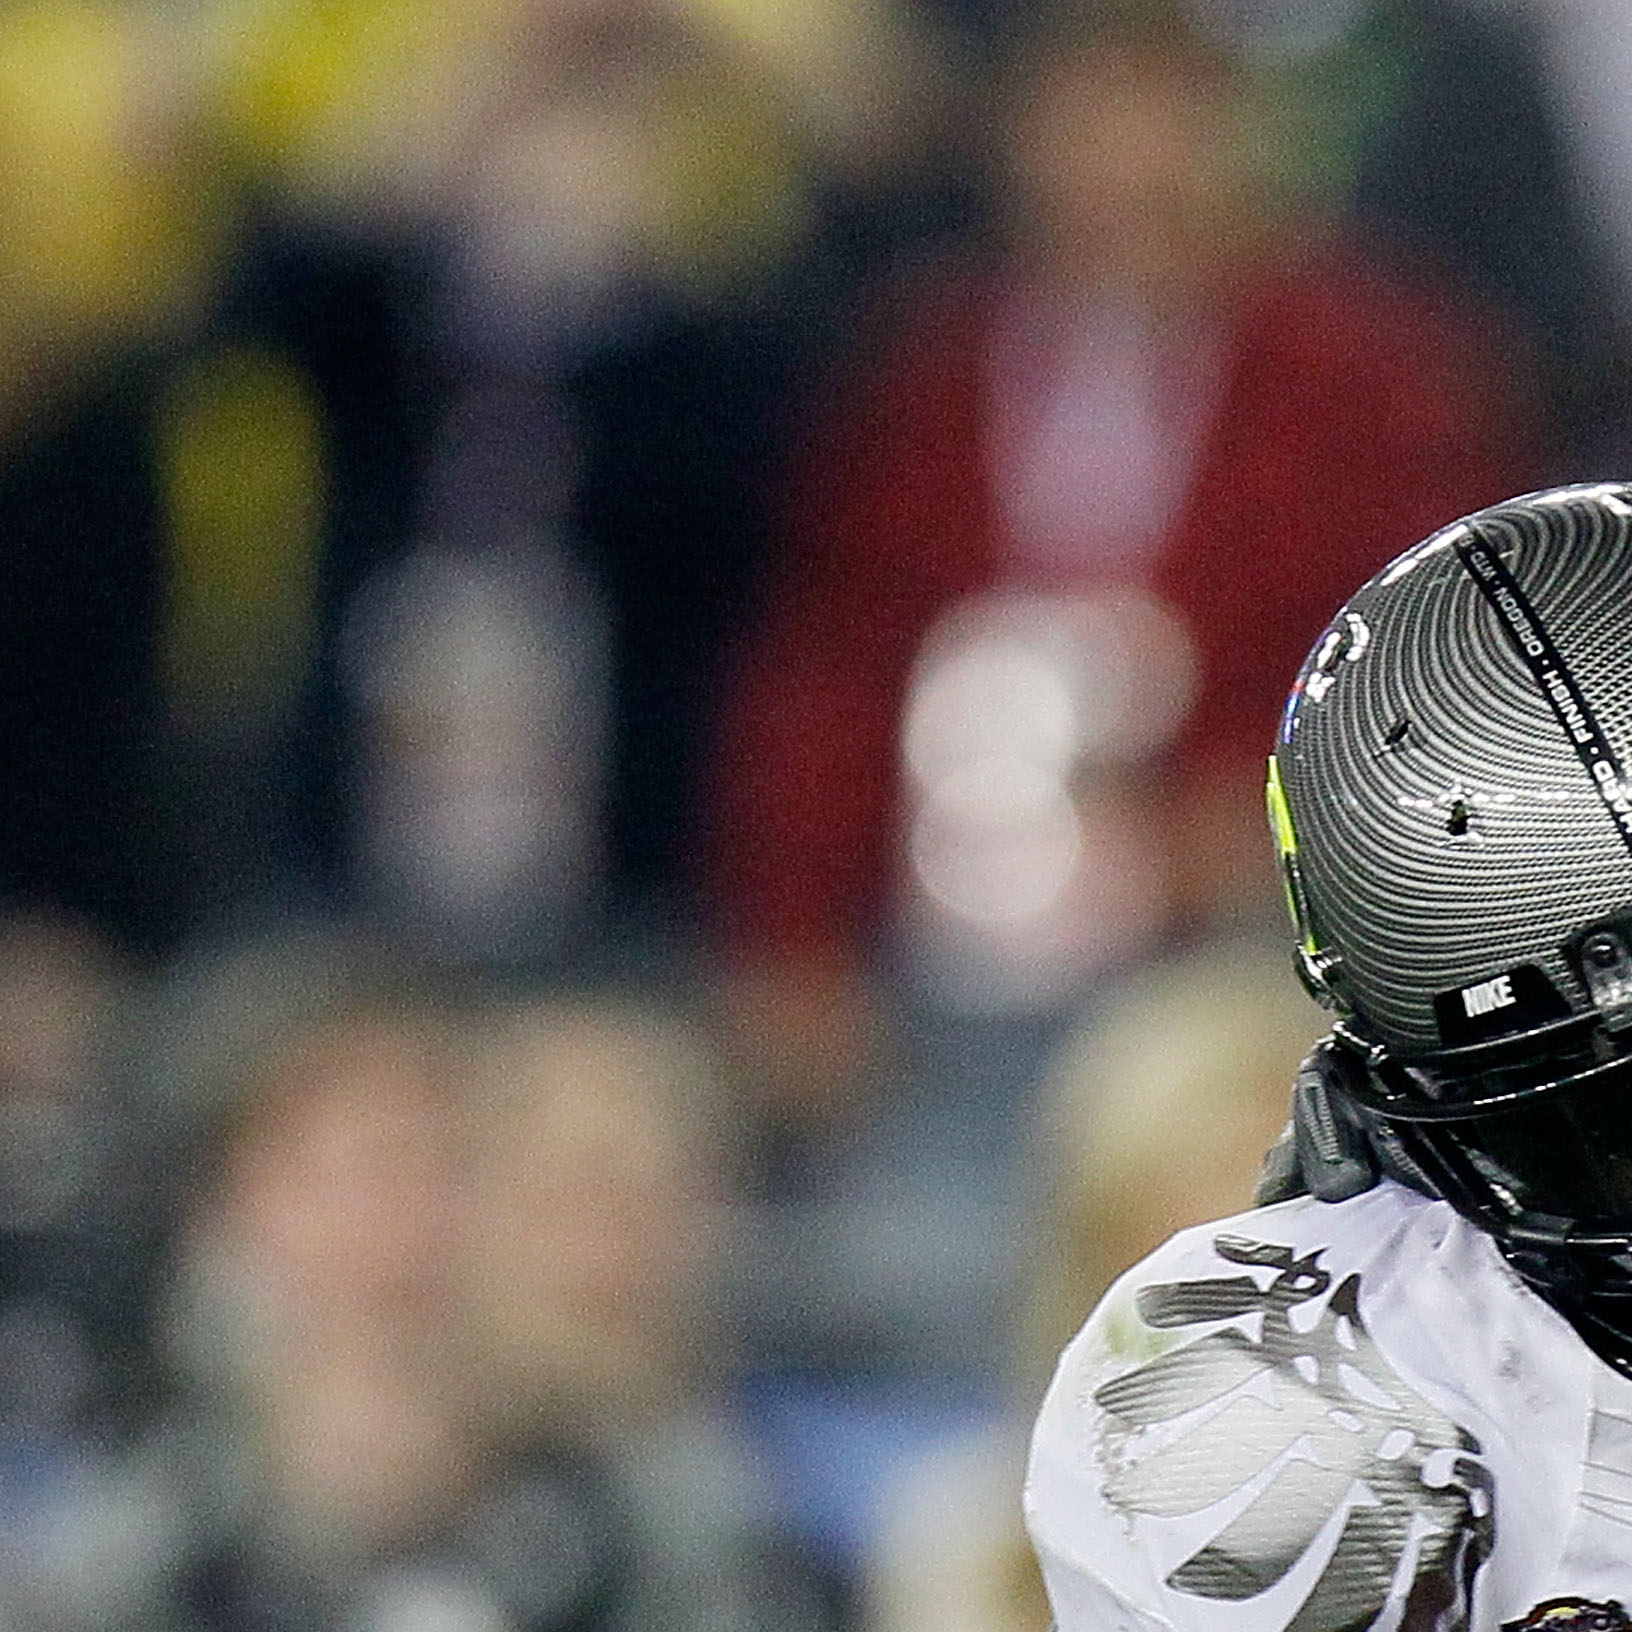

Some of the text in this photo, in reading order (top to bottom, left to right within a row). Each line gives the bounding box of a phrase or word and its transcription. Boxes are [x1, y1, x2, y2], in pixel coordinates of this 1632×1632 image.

[1492, 585, 1546, 658] OREGON
[1540, 669, 1595, 744] FINISH
[1461, 974, 1517, 1019] NIKE
